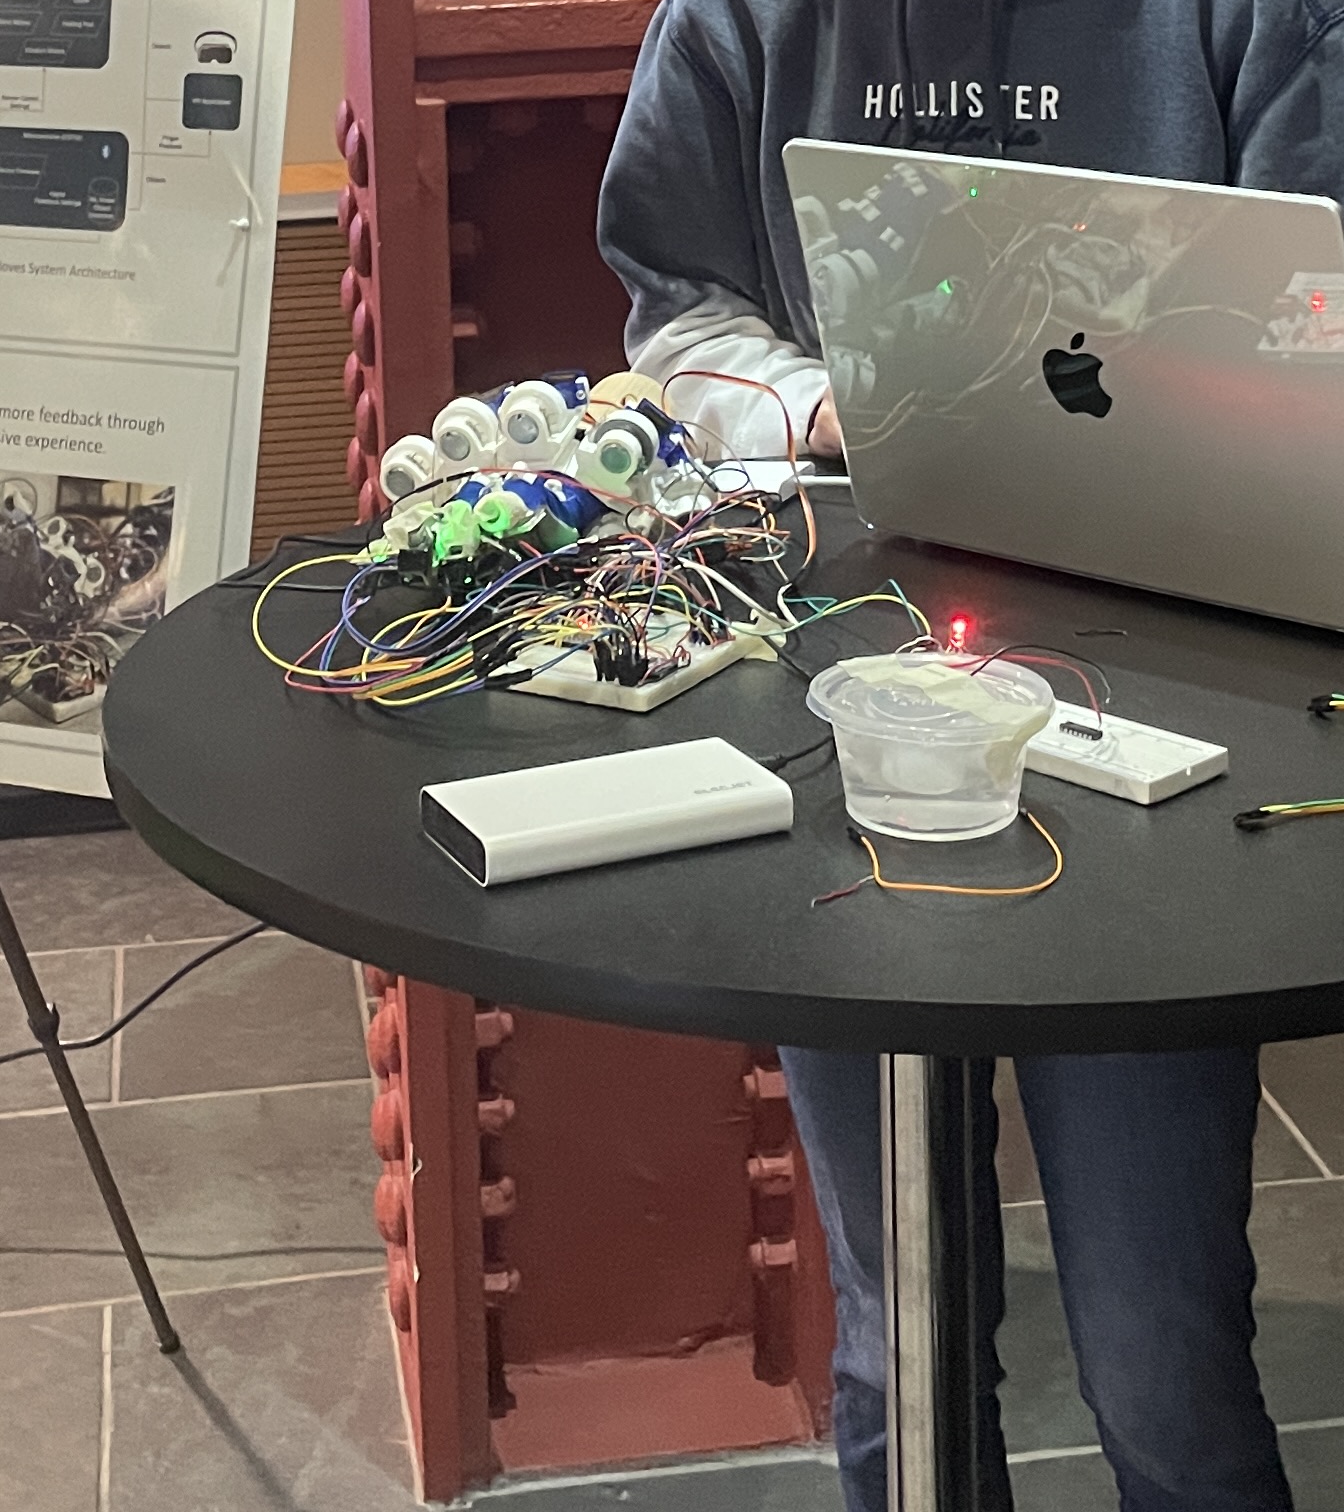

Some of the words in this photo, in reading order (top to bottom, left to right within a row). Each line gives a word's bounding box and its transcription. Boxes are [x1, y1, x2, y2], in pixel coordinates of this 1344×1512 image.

[69, 265, 136, 281] Architecture
[39, 405, 104, 429] feedback
[107, 413, 165, 436] through
[25, 433, 106, 455] experience.
